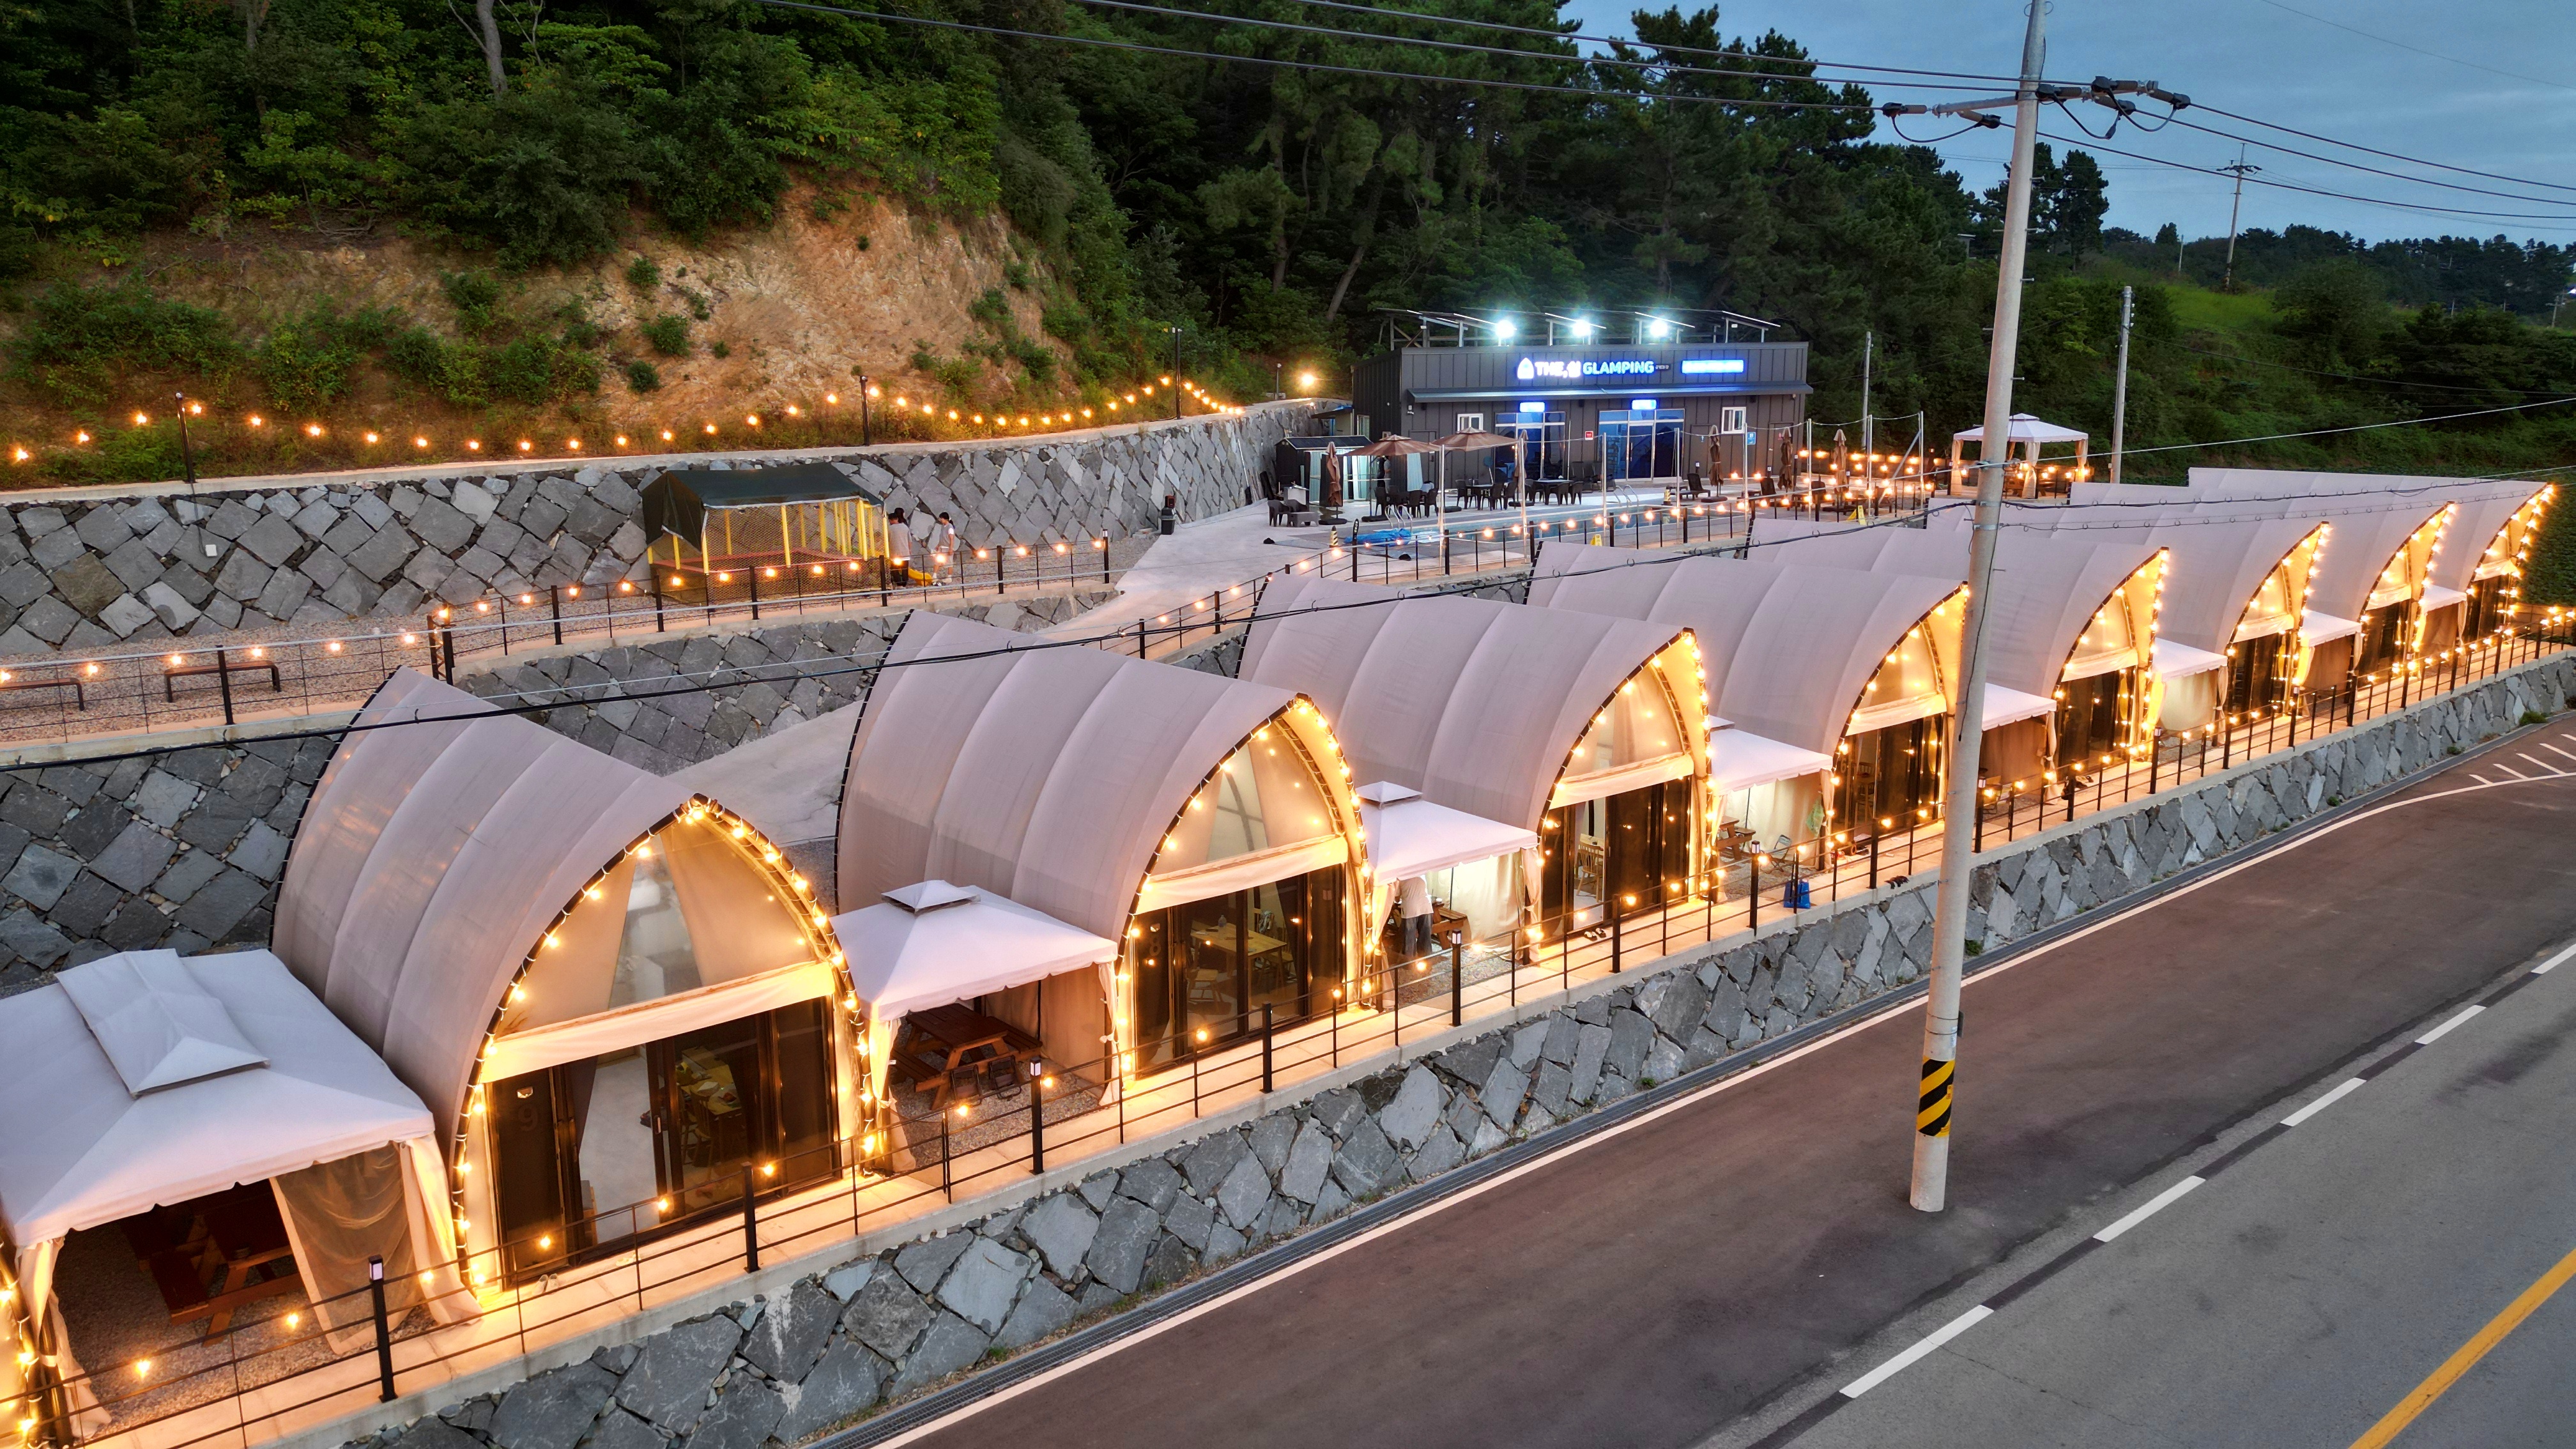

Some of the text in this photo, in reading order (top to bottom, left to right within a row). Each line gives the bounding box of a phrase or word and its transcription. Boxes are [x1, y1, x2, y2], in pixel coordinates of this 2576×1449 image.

[1583, 361, 1654, 374] GLAMPING
[1840, 758, 1847, 773] 6
[1149, 935, 1161, 956] 8
[518, 1104, 539, 1131] 9
